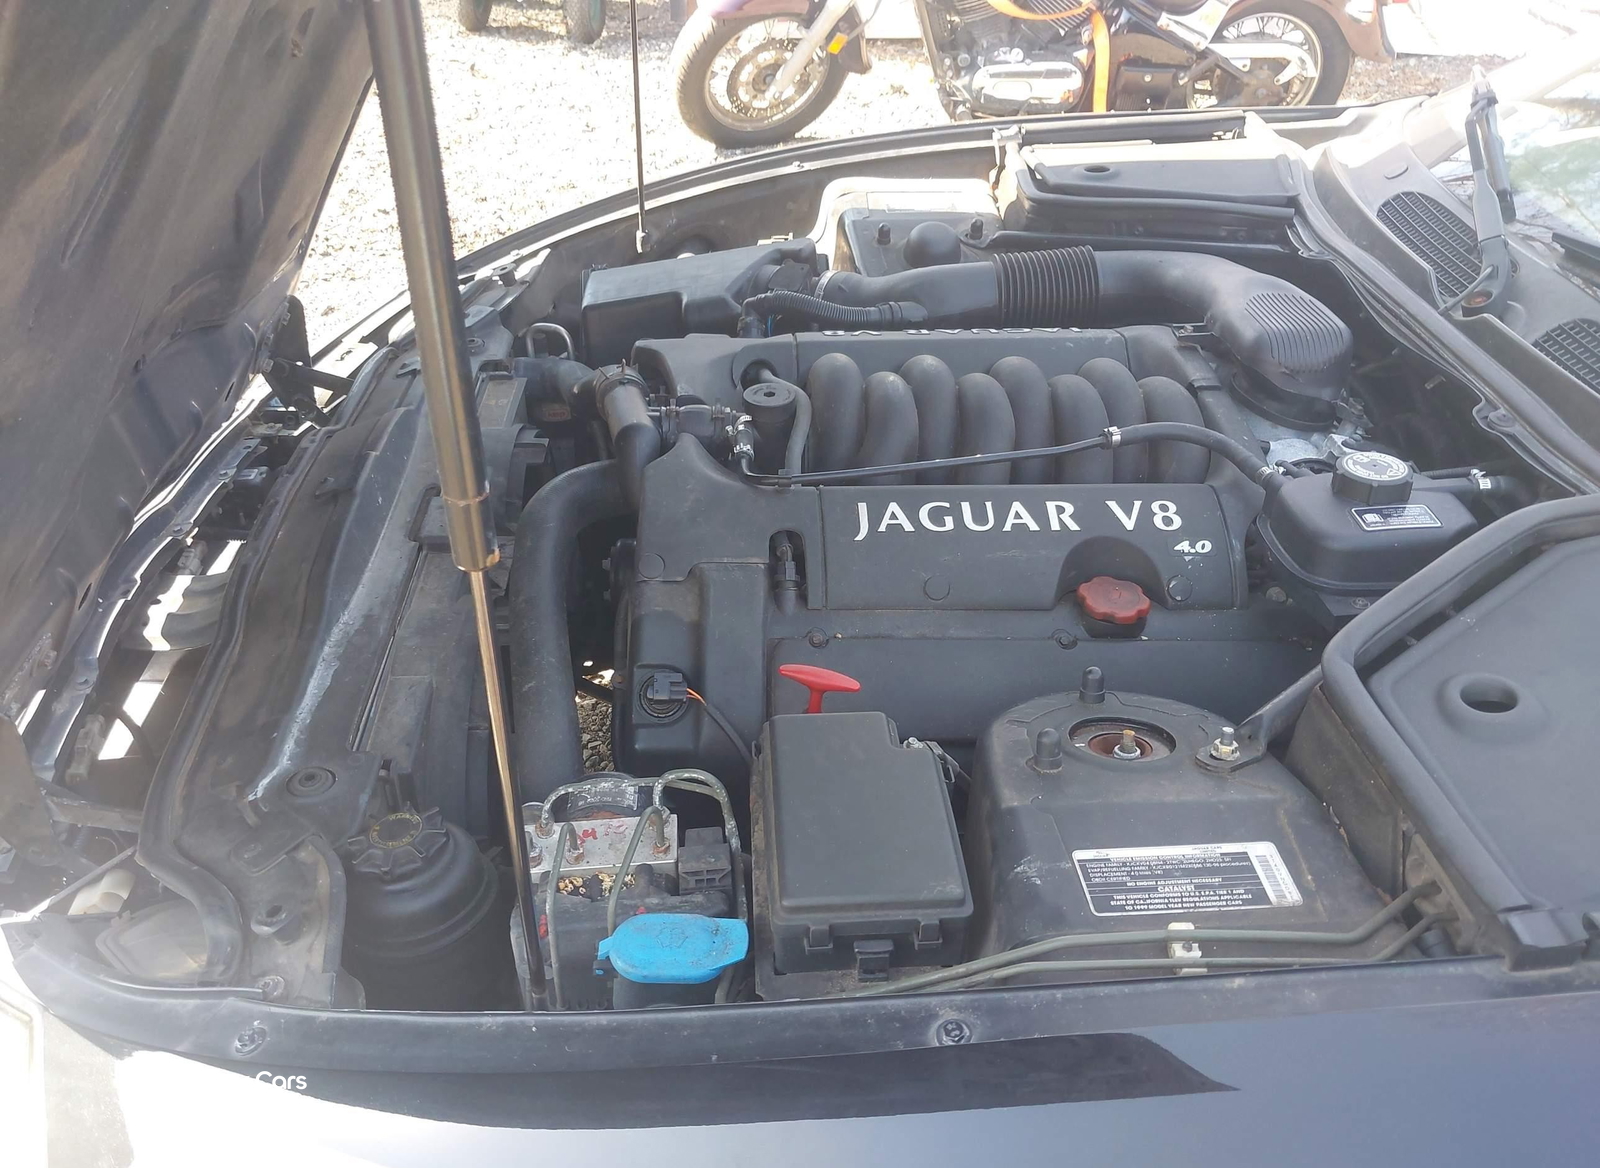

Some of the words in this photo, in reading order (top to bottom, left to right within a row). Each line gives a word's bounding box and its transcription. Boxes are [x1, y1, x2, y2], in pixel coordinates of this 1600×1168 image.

[854, 500, 1081, 541] JAGUAR
[1105, 500, 1183, 532] V8
[1173, 540, 1212, 553] 4.0
[1157, 885, 1195, 893] CATALYST
